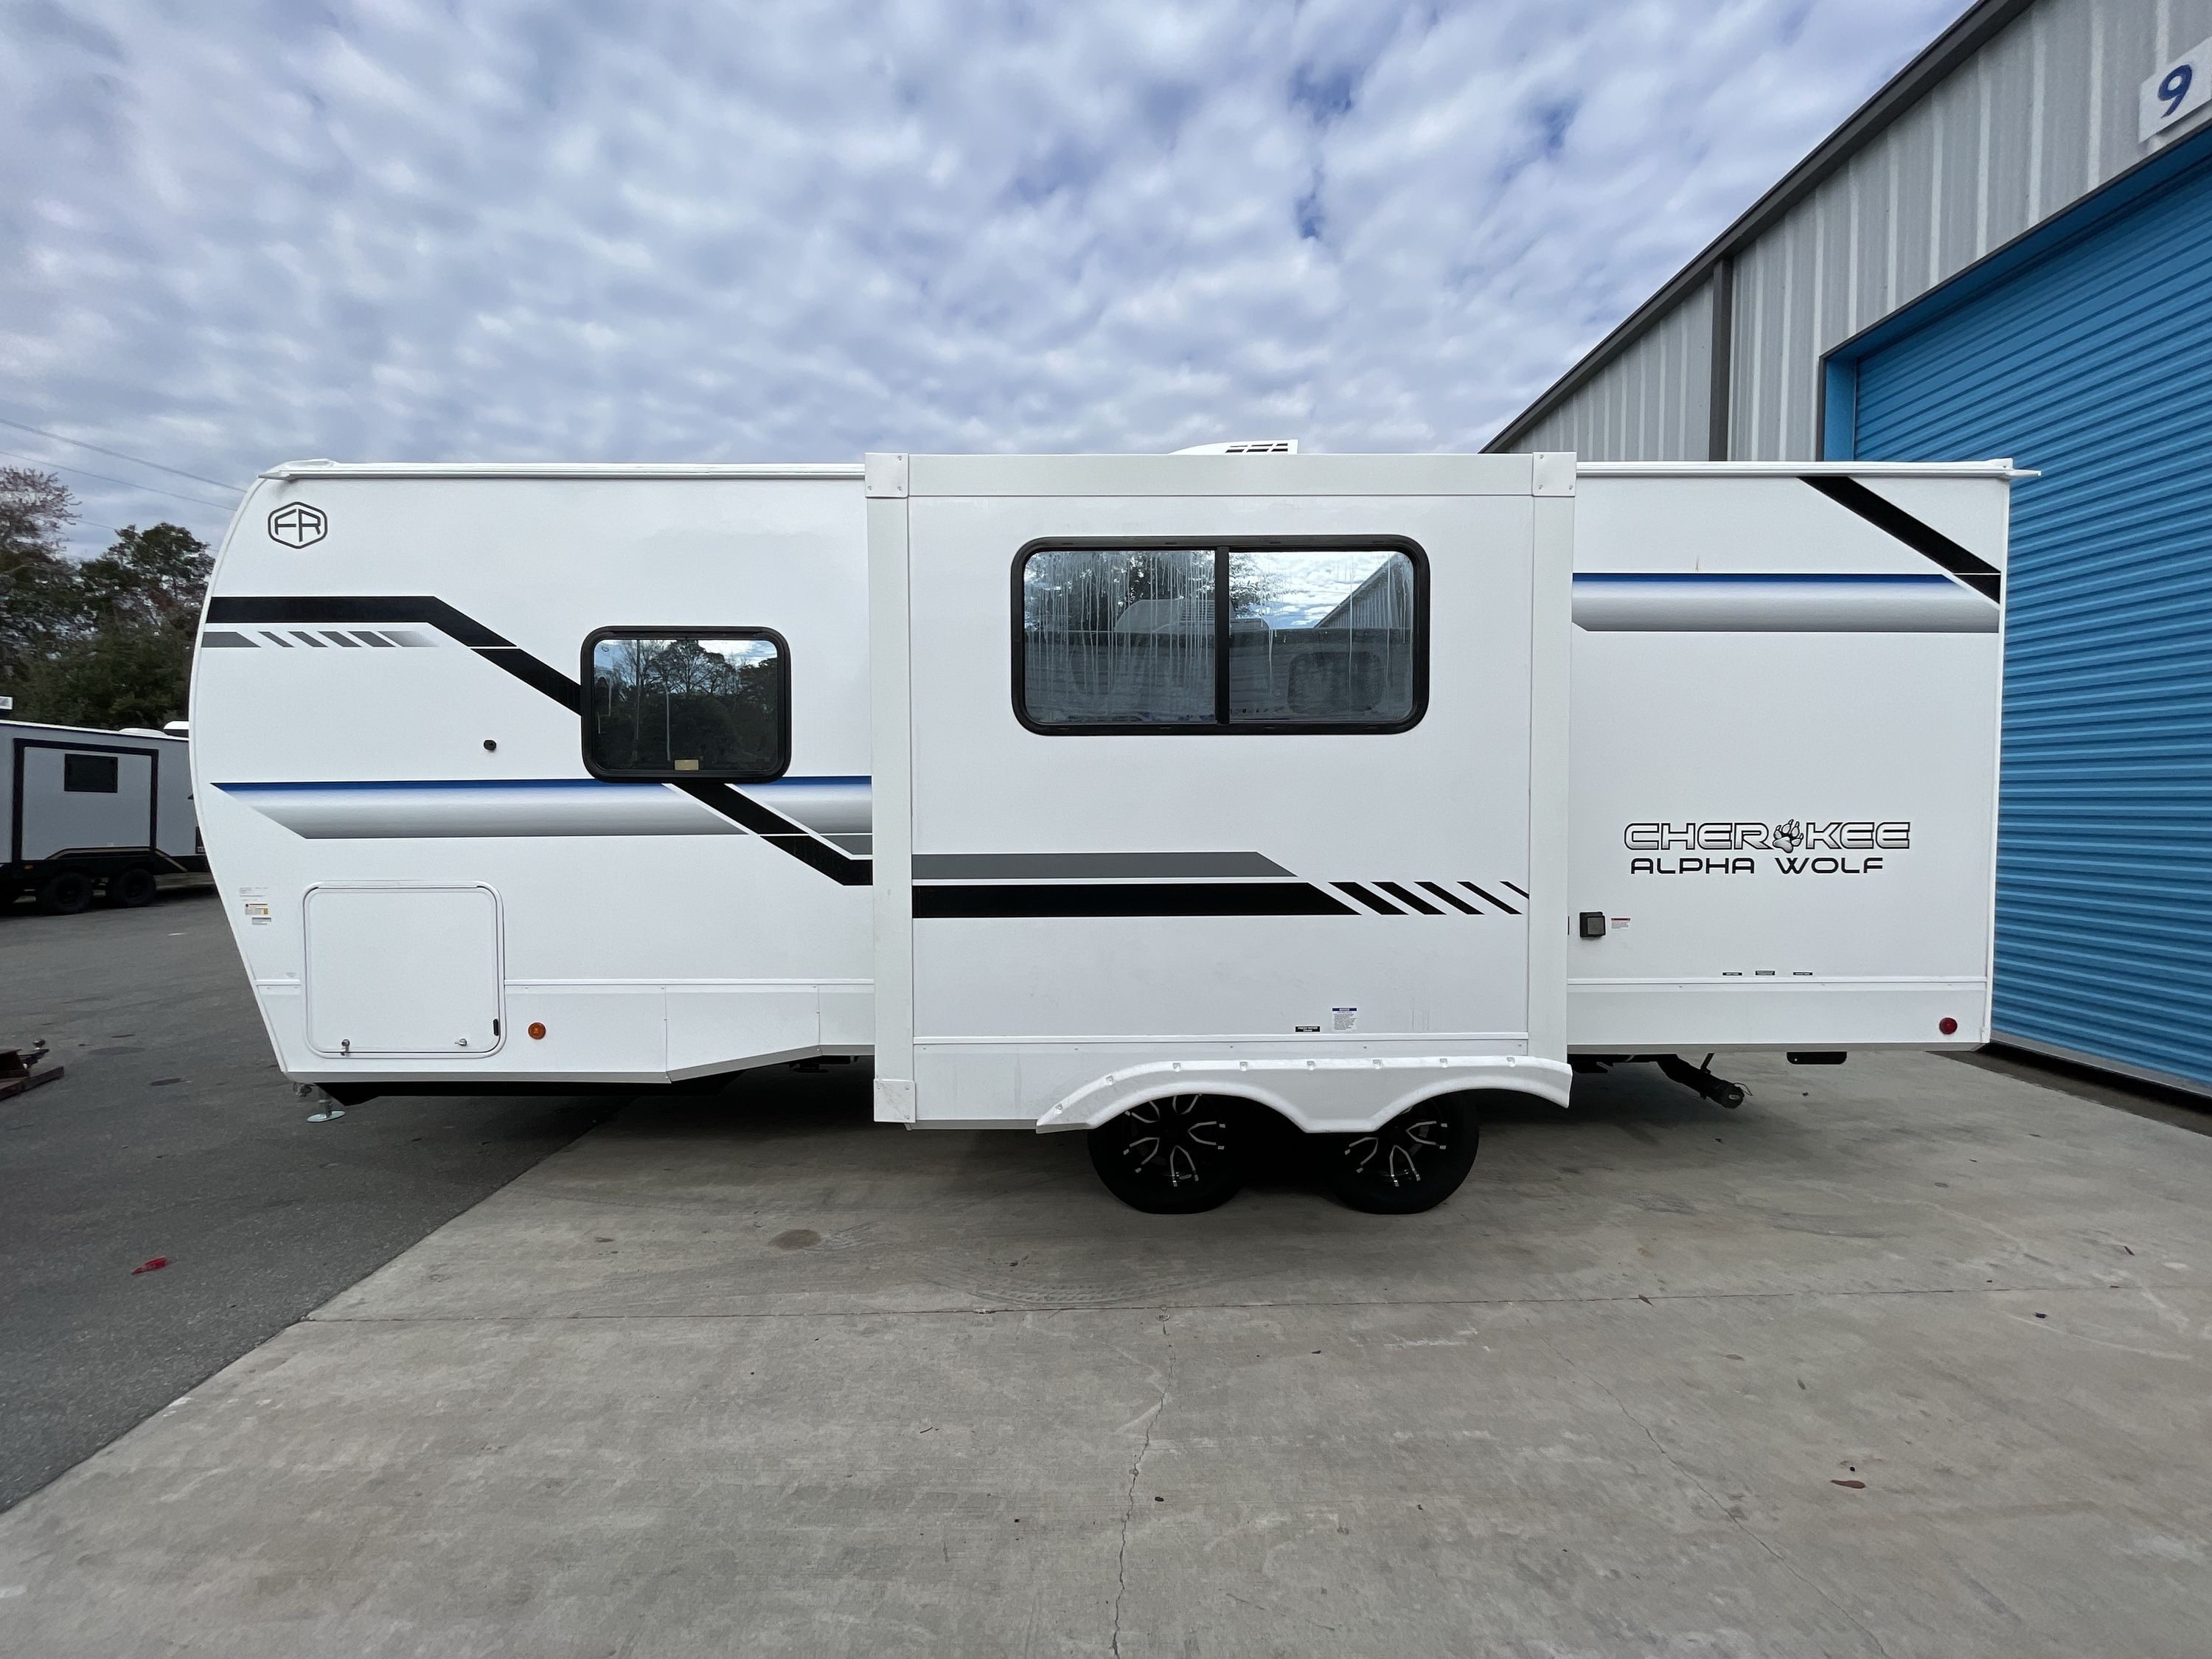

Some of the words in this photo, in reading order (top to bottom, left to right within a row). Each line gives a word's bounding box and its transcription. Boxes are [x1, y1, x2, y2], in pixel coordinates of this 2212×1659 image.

[2157, 65, 2192, 119] 9
[1631, 858, 1754, 874] ALPHA
[1775, 857, 1883, 874] WOLF
